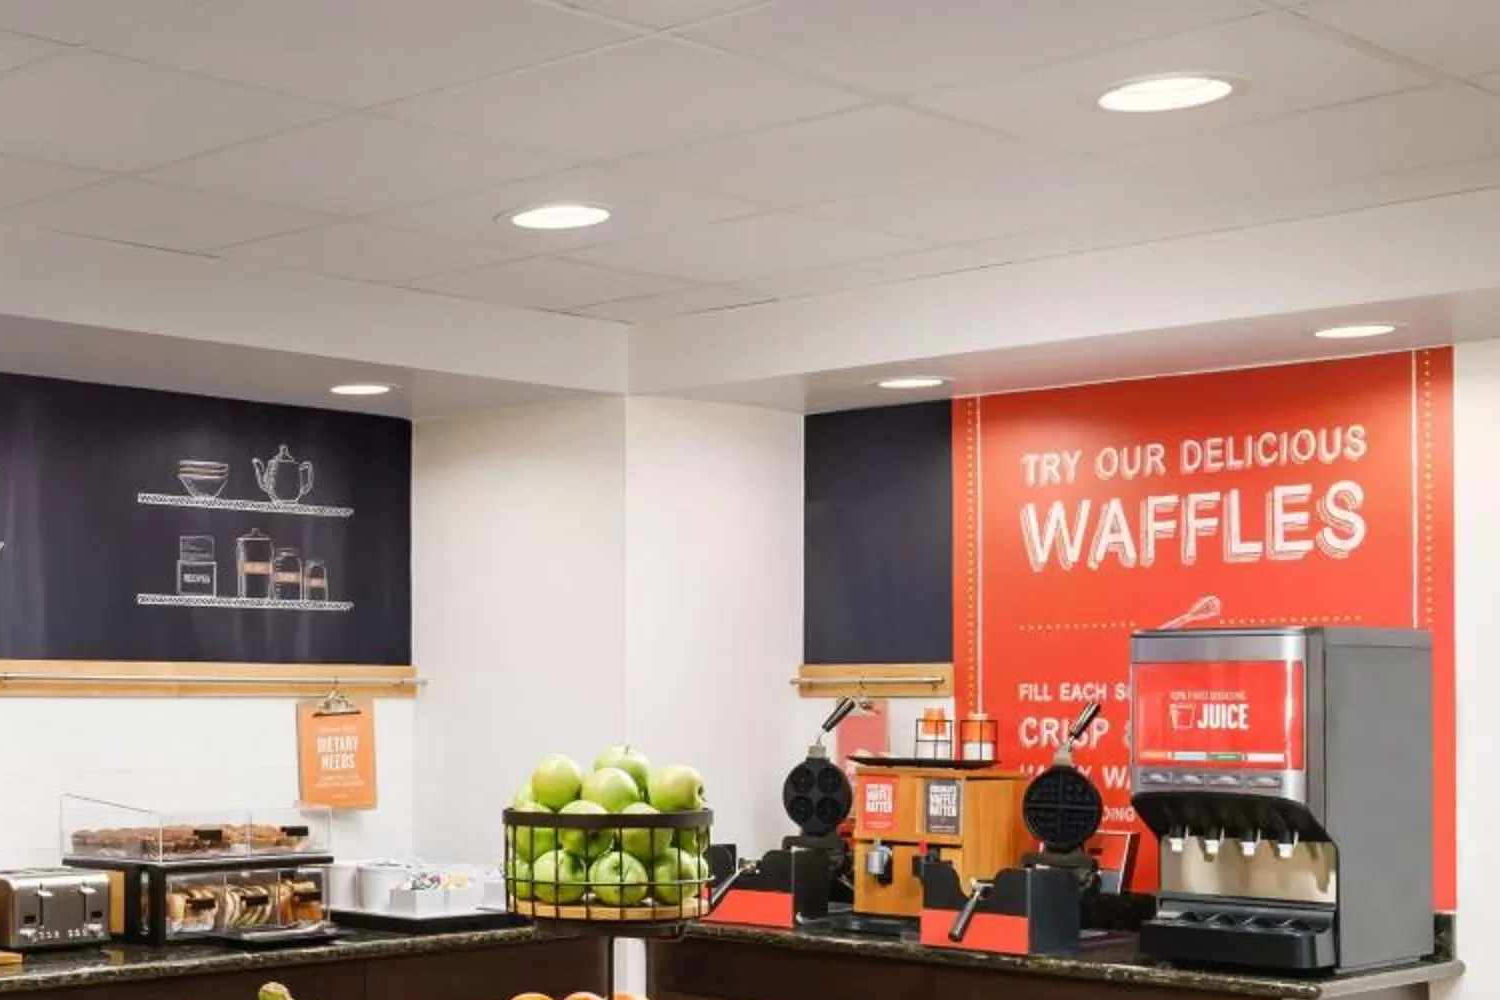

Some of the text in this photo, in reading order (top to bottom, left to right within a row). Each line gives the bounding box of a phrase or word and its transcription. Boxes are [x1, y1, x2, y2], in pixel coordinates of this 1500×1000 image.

[1023, 424, 1366, 485] TRY OUR DELICIOUS
[1019, 480, 1366, 573] WAFFLES
[1019, 683, 1052, 702] FILL
[1060, 683, 1107, 701] EACH
[1197, 703, 1249, 729] JUICE
